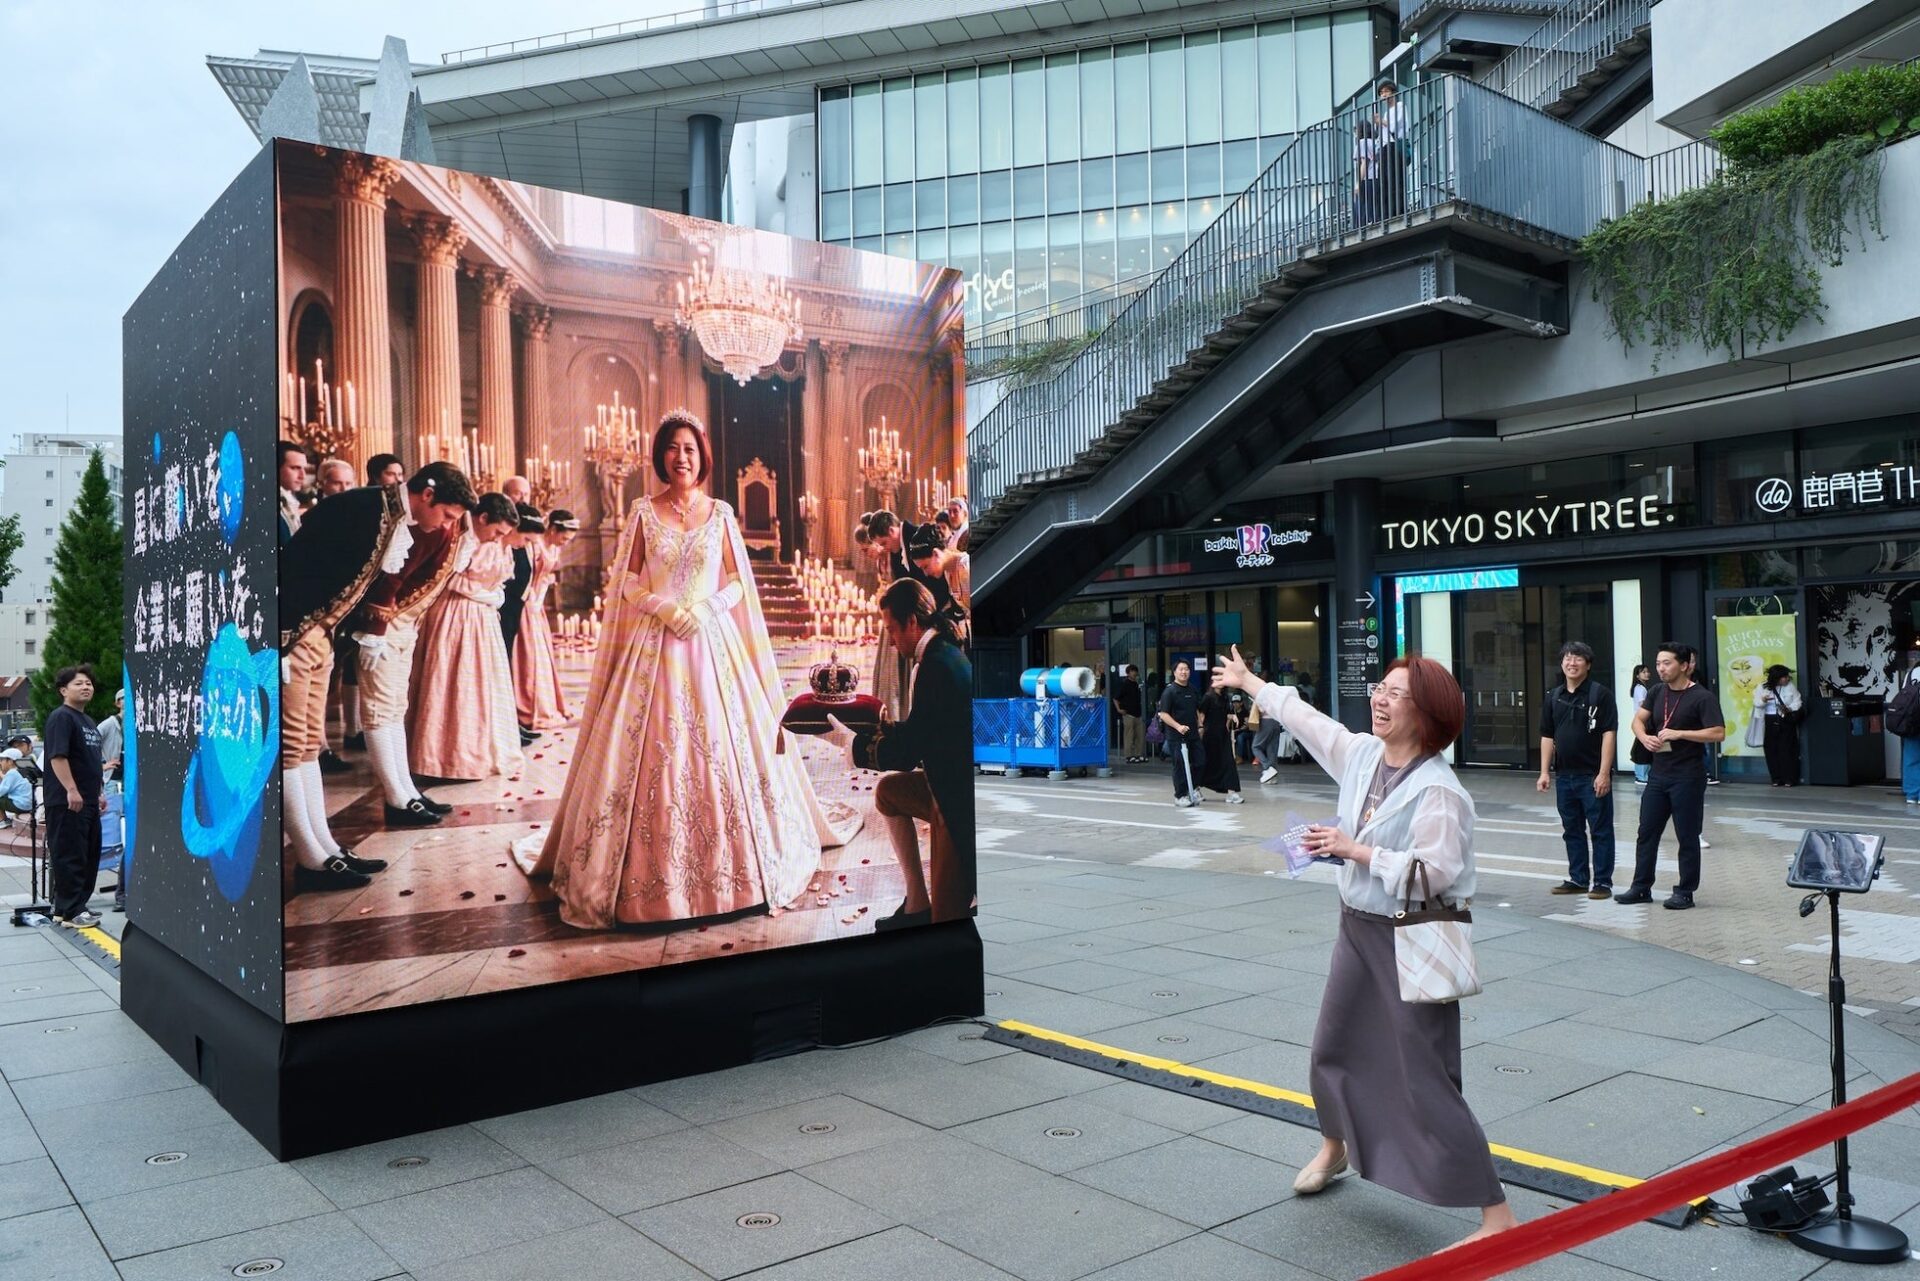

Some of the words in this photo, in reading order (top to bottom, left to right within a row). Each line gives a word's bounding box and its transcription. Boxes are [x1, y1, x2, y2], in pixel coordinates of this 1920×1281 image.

[1802, 468, 1885, 508] 鹿角巷
[1204, 537, 1238, 552] baskin
[1236, 523, 1272, 555] BR
[1271, 530, 1308, 546] robbins
[1382, 513, 1484, 550] TOKYO
[1236, 553, 1274, 568] サーティワン
[134, 556, 264, 654] 企業に願いを。
[1725, 640, 1750, 656] TEA
[1751, 638, 1785, 648] DAYS
[1727, 630, 1763, 645] JUICY
